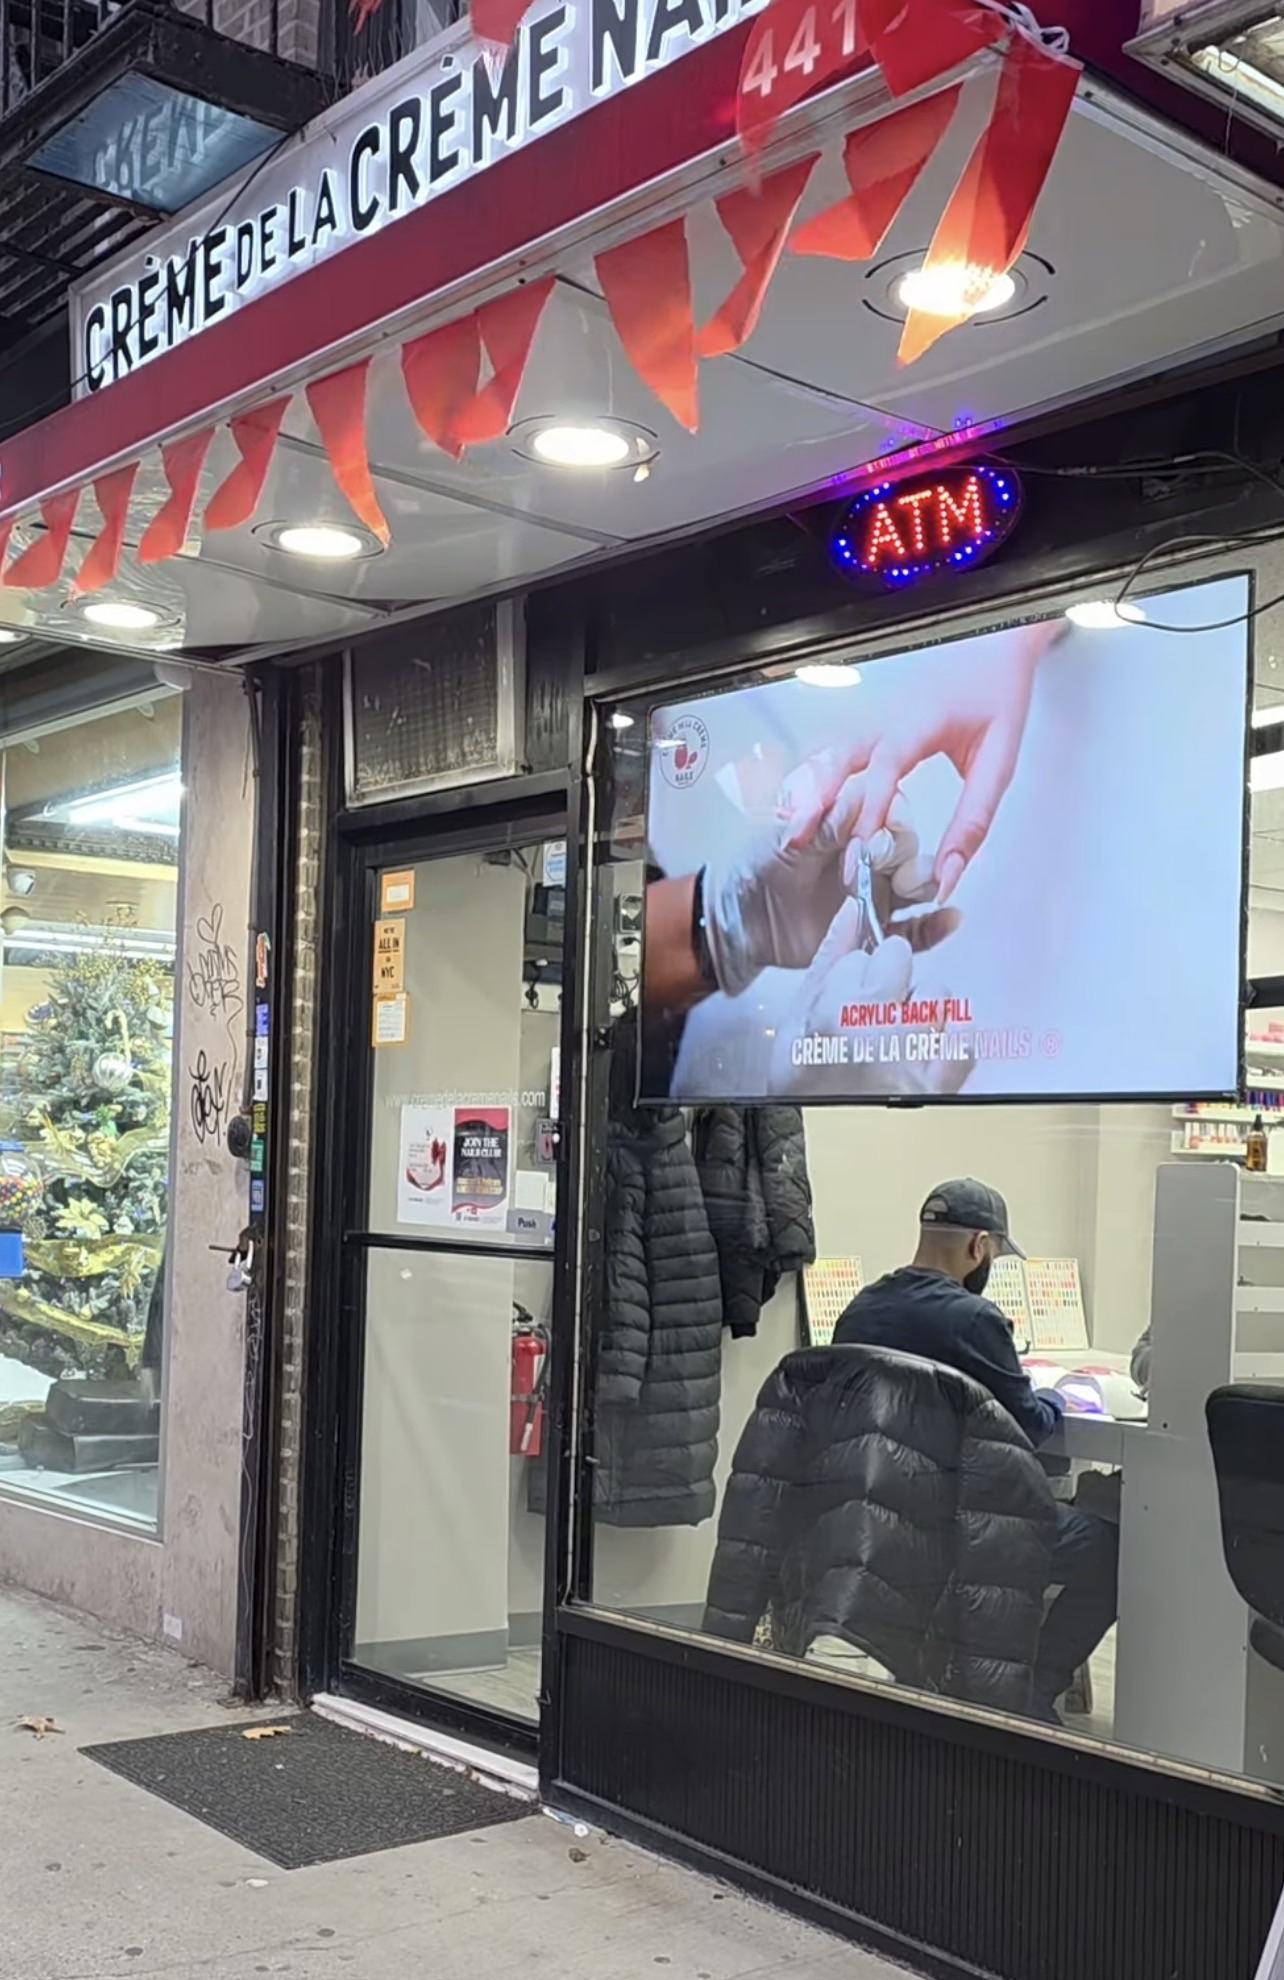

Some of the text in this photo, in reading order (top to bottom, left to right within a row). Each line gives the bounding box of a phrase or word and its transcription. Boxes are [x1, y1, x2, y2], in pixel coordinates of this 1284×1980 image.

[85, 229, 228, 392] CRÈME
[236, 206, 278, 290] DE
[287, 172, 338, 259] LA
[350, 4, 567, 232] CRÈME
[867, 474, 981, 563] ATM
[381, 966, 394, 978] NYC
[841, 998, 972, 1027] ACRYLIC BACK FILL
[791, 1032, 849, 1066] CRÈME
[853, 1035, 875, 1063] DE
[879, 1034, 900, 1062] LA
[905, 1028, 969, 1062] CRÈME
[974, 1028, 1032, 1060] NAILS
[463, 1136, 500, 1148] JOIN THE
[517, 1216, 537, 1230] Push
